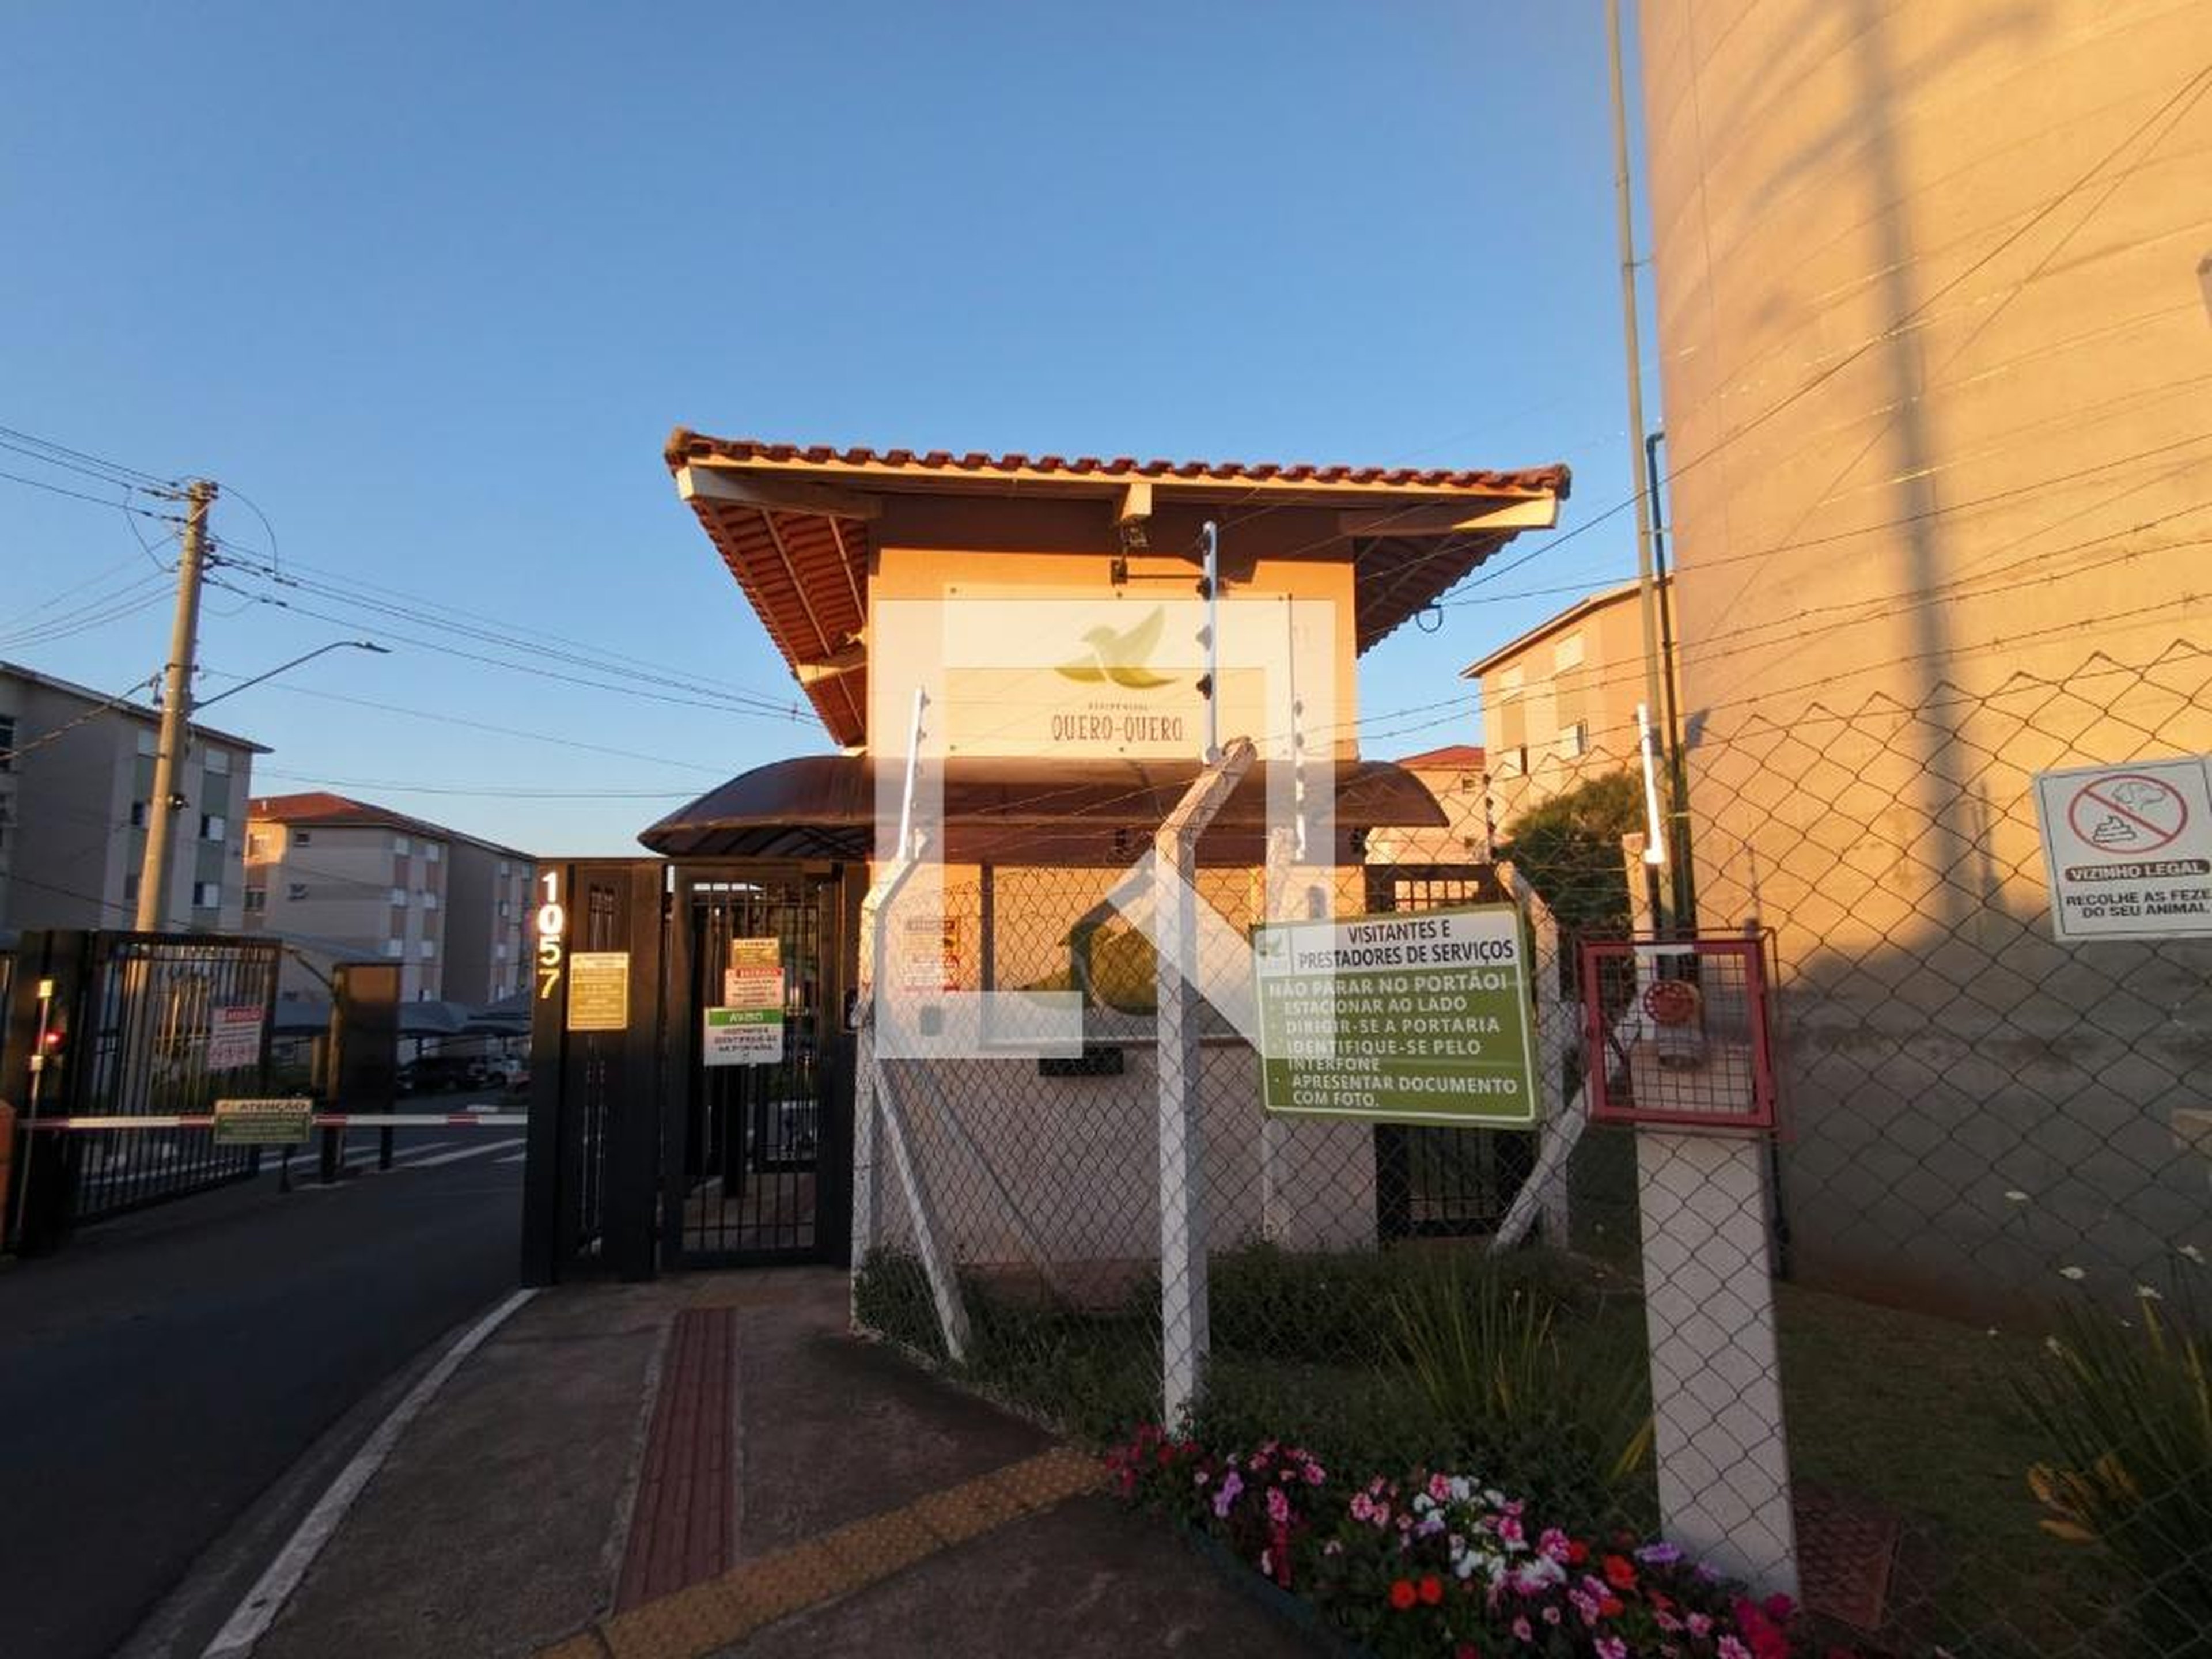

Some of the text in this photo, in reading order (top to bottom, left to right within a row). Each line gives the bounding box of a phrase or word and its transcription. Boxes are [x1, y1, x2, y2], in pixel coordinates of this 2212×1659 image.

[1052, 714, 1183, 741] QUERO-QUERO
[2071, 861, 2204, 880] VIZINHO LEGAL
[2066, 889, 2212, 906] RECOLHE AS FEZE
[2082, 907, 2104, 918] DO
[2109, 906, 2141, 917] SEU
[538, 872, 563, 999] 1057
[1348, 920, 1450, 944] VISITANTES E
[1299, 940, 1514, 969] PRESTADORES DE SERVIÇOS
[1270, 978, 1306, 997] NÃO
[1313, 977, 1372, 996] PARAR
[1380, 976, 1407, 994] NO
[1285, 997, 1467, 1016] ESTACIONAR AO LADO
[1403, 1017, 1500, 1032] PORTARIA
[1288, 1040, 1481, 1056] IDENTIFIQUE-SE PELO
[1289, 1058, 1381, 1072] INTERFONE
[1292, 1075, 1517, 1094] APRESENTAR DOCUMENTO
[1293, 1093, 1380, 1107] COM FOTO.
